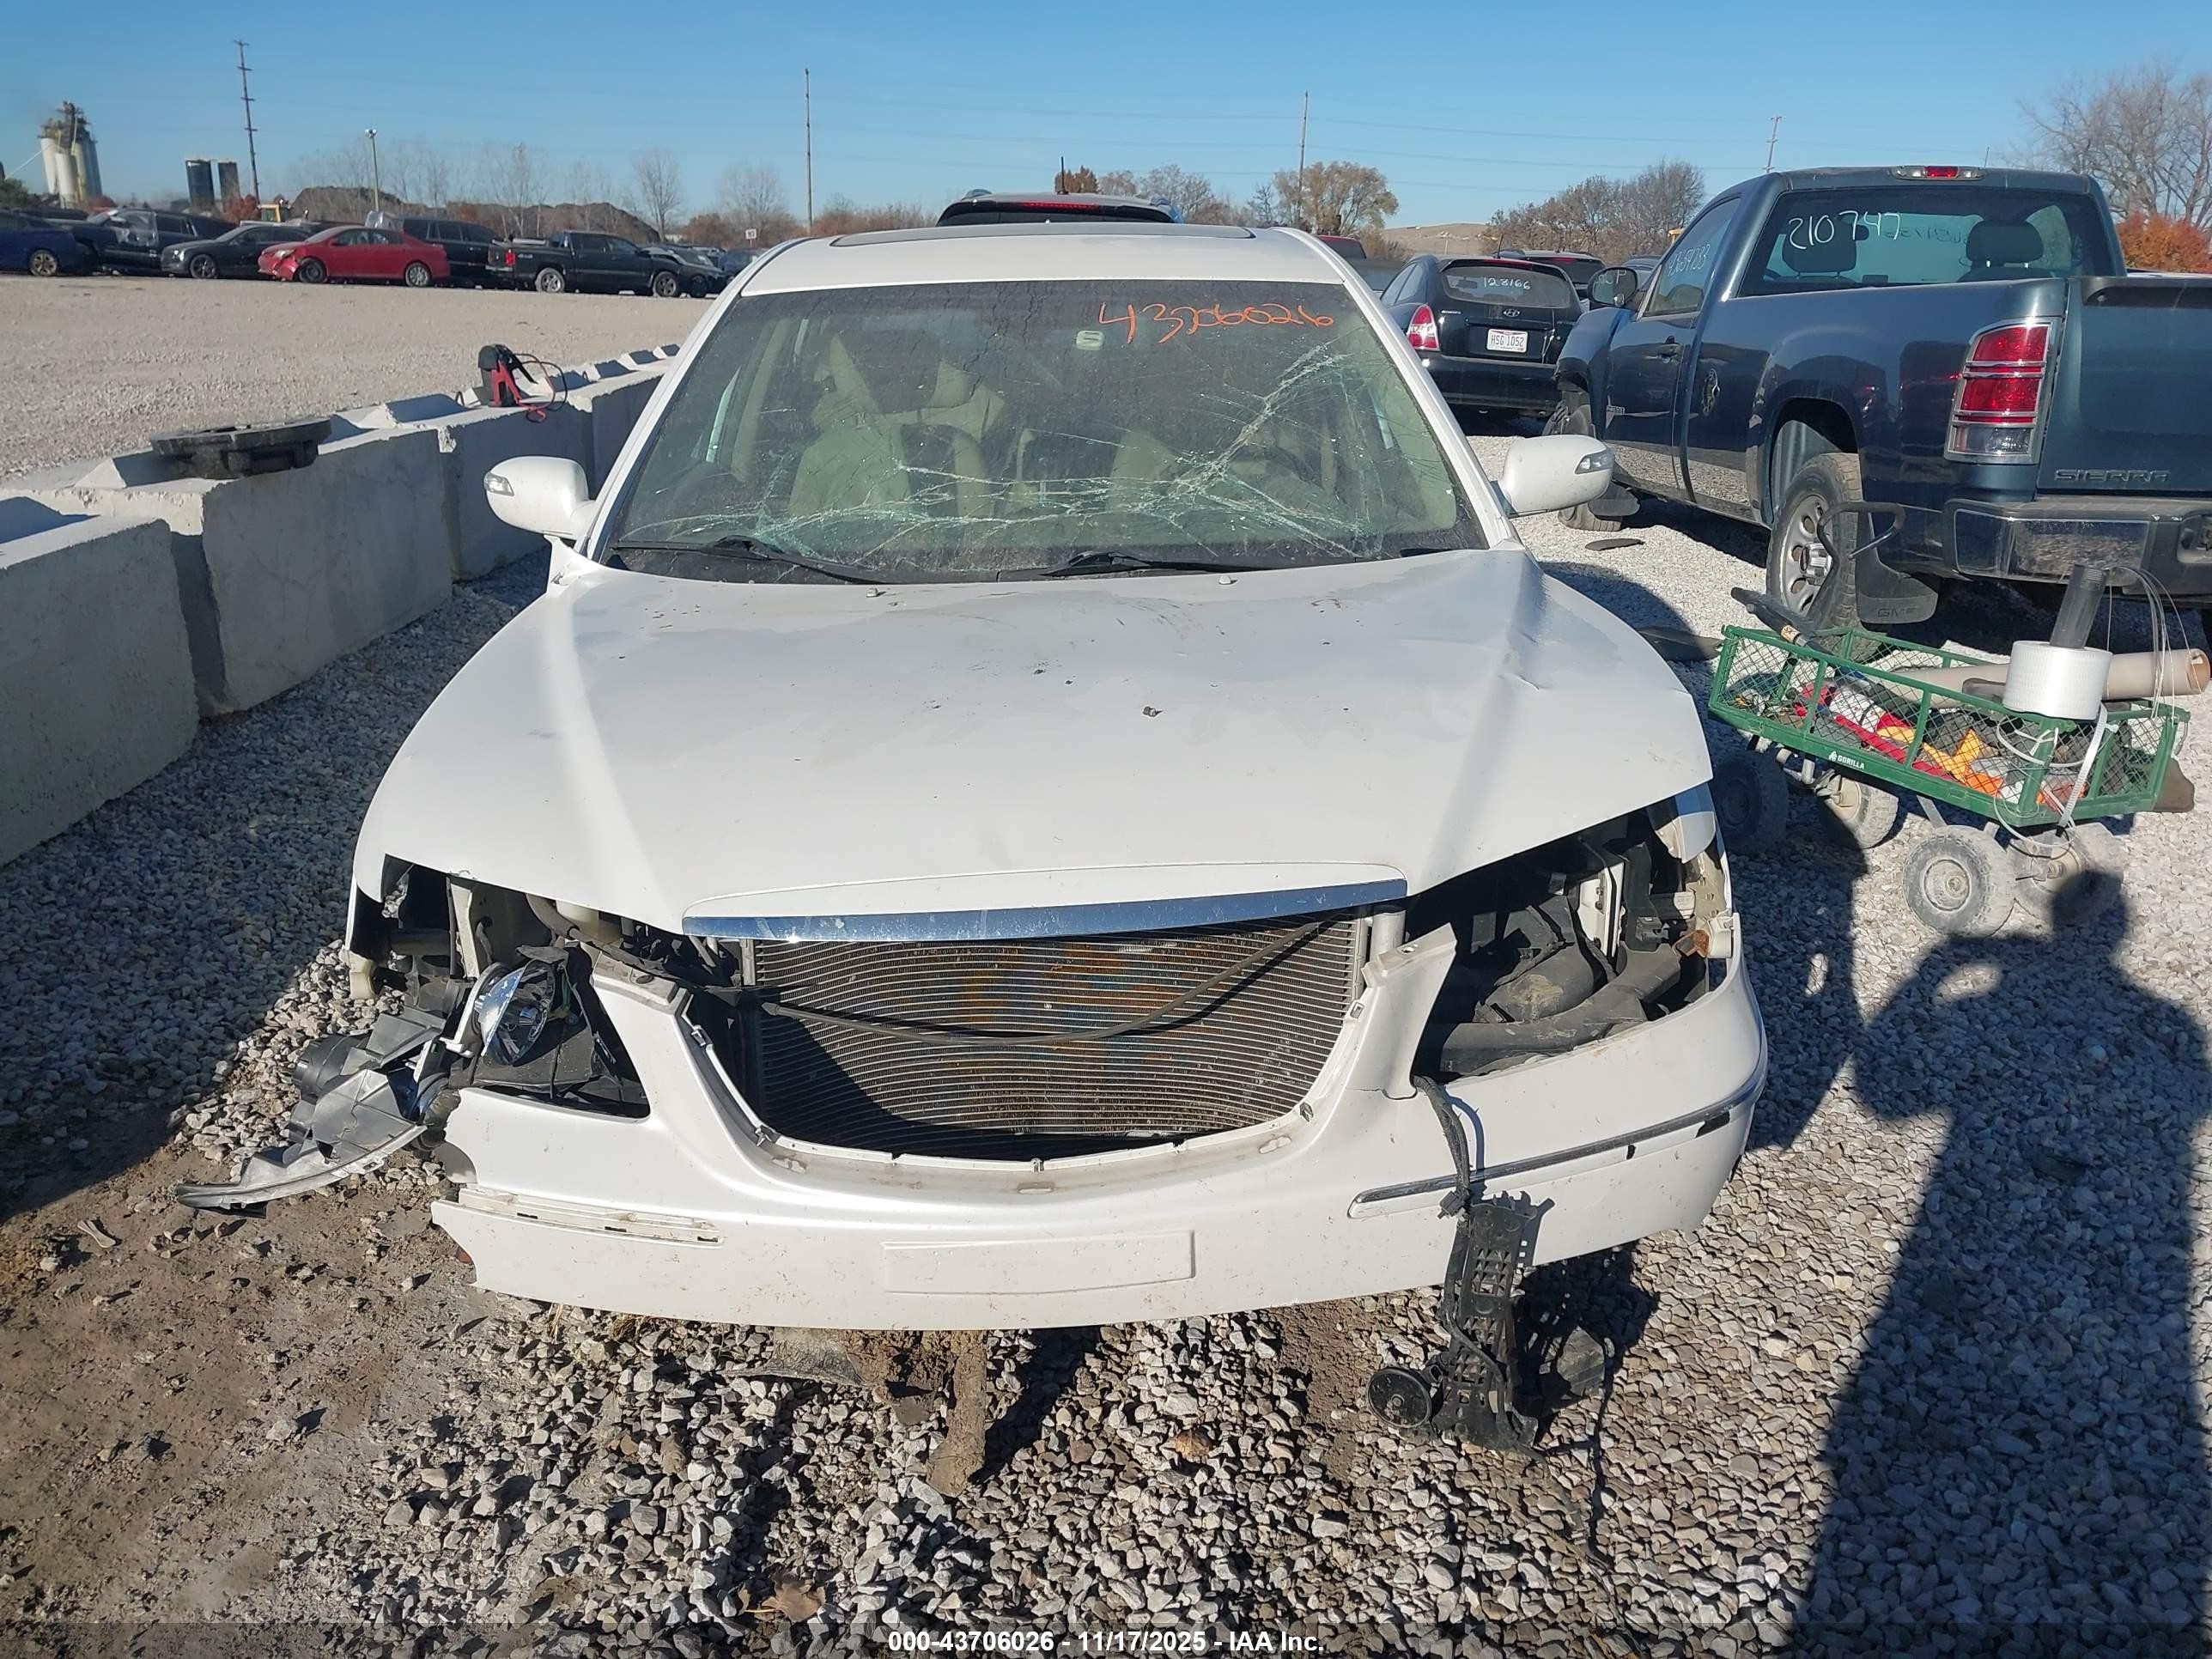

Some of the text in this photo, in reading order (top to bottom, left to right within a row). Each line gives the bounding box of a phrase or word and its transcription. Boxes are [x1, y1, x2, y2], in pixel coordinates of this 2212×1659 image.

[1789, 210, 1900, 250] 210747
[1484, 277, 1531, 290] 128166
[1507, 335, 1525, 347] 1052
[2054, 469, 2171, 482] SIERRA
[1838, 755, 1865, 769] GORILLA
